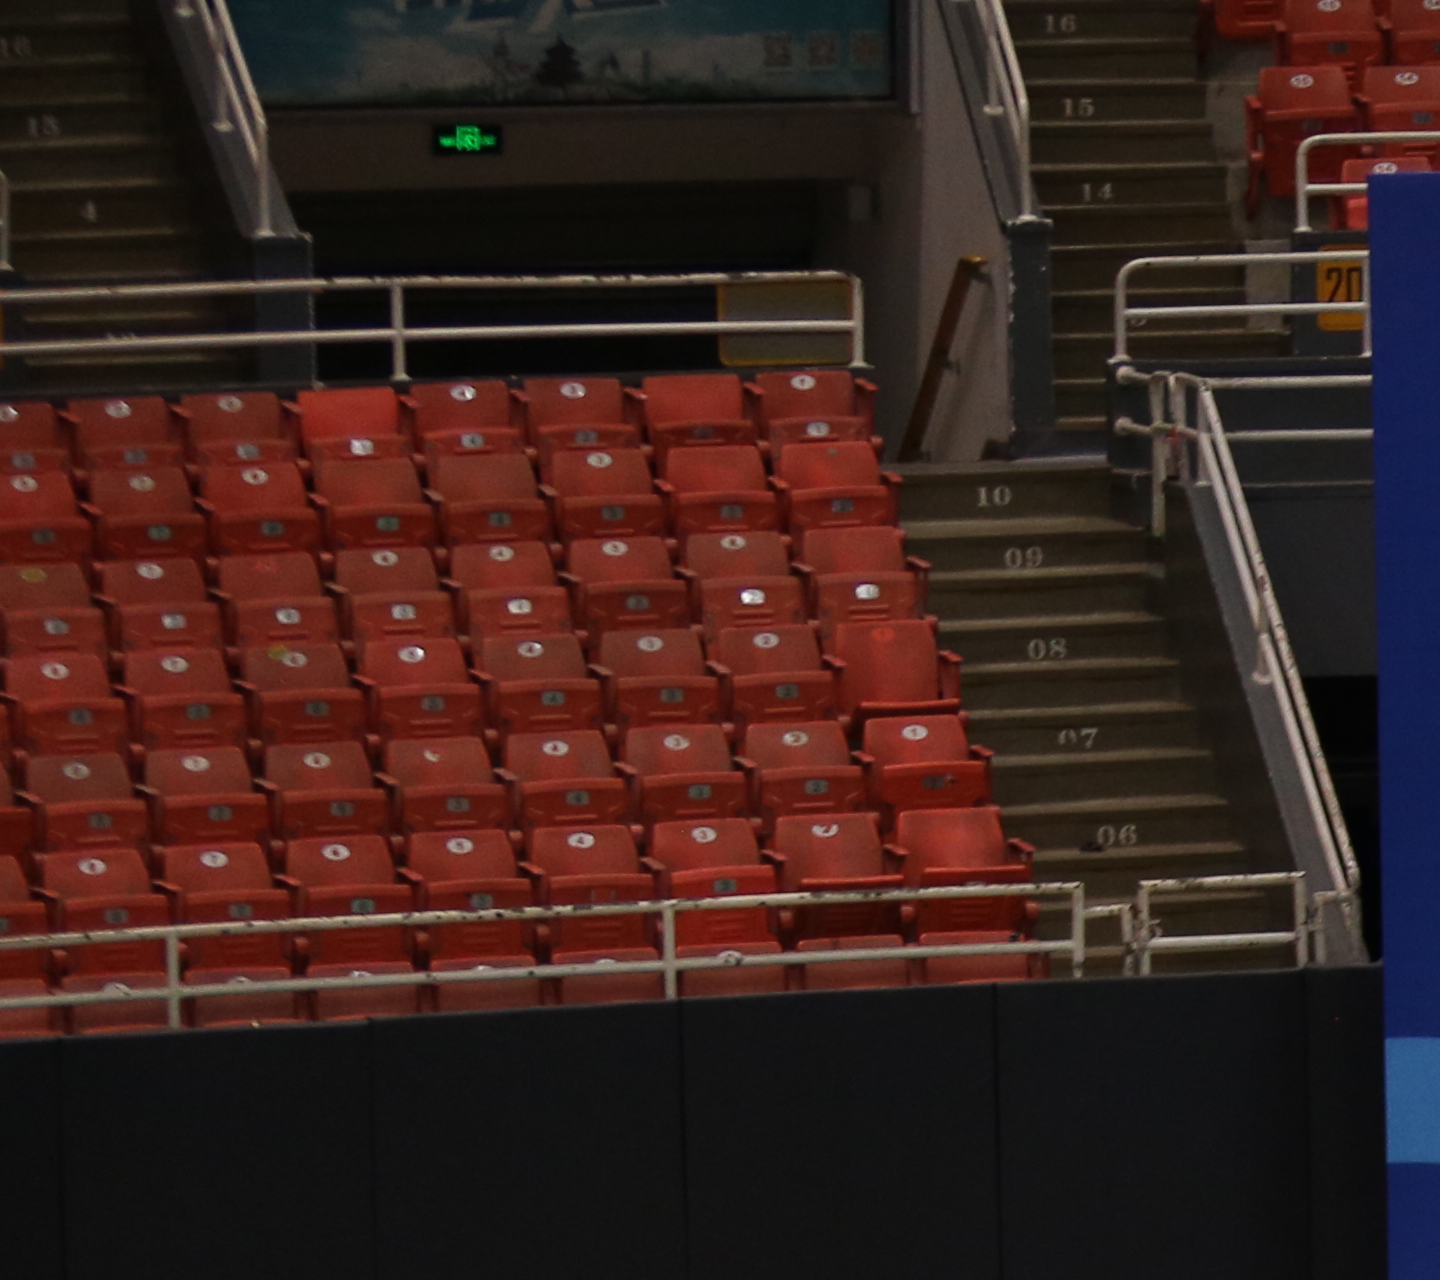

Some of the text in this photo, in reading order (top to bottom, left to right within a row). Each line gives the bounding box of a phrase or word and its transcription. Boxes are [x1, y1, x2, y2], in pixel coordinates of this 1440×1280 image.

[1045, 14, 1077, 33] 16
[1061, 98, 1094, 117] 15
[1081, 183, 1113, 202] 14
[976, 485, 1013, 508] 10
[1003, 545, 1044, 569] 09
[1026, 637, 1068, 660] 08
[1096, 824, 1138, 846] 06
